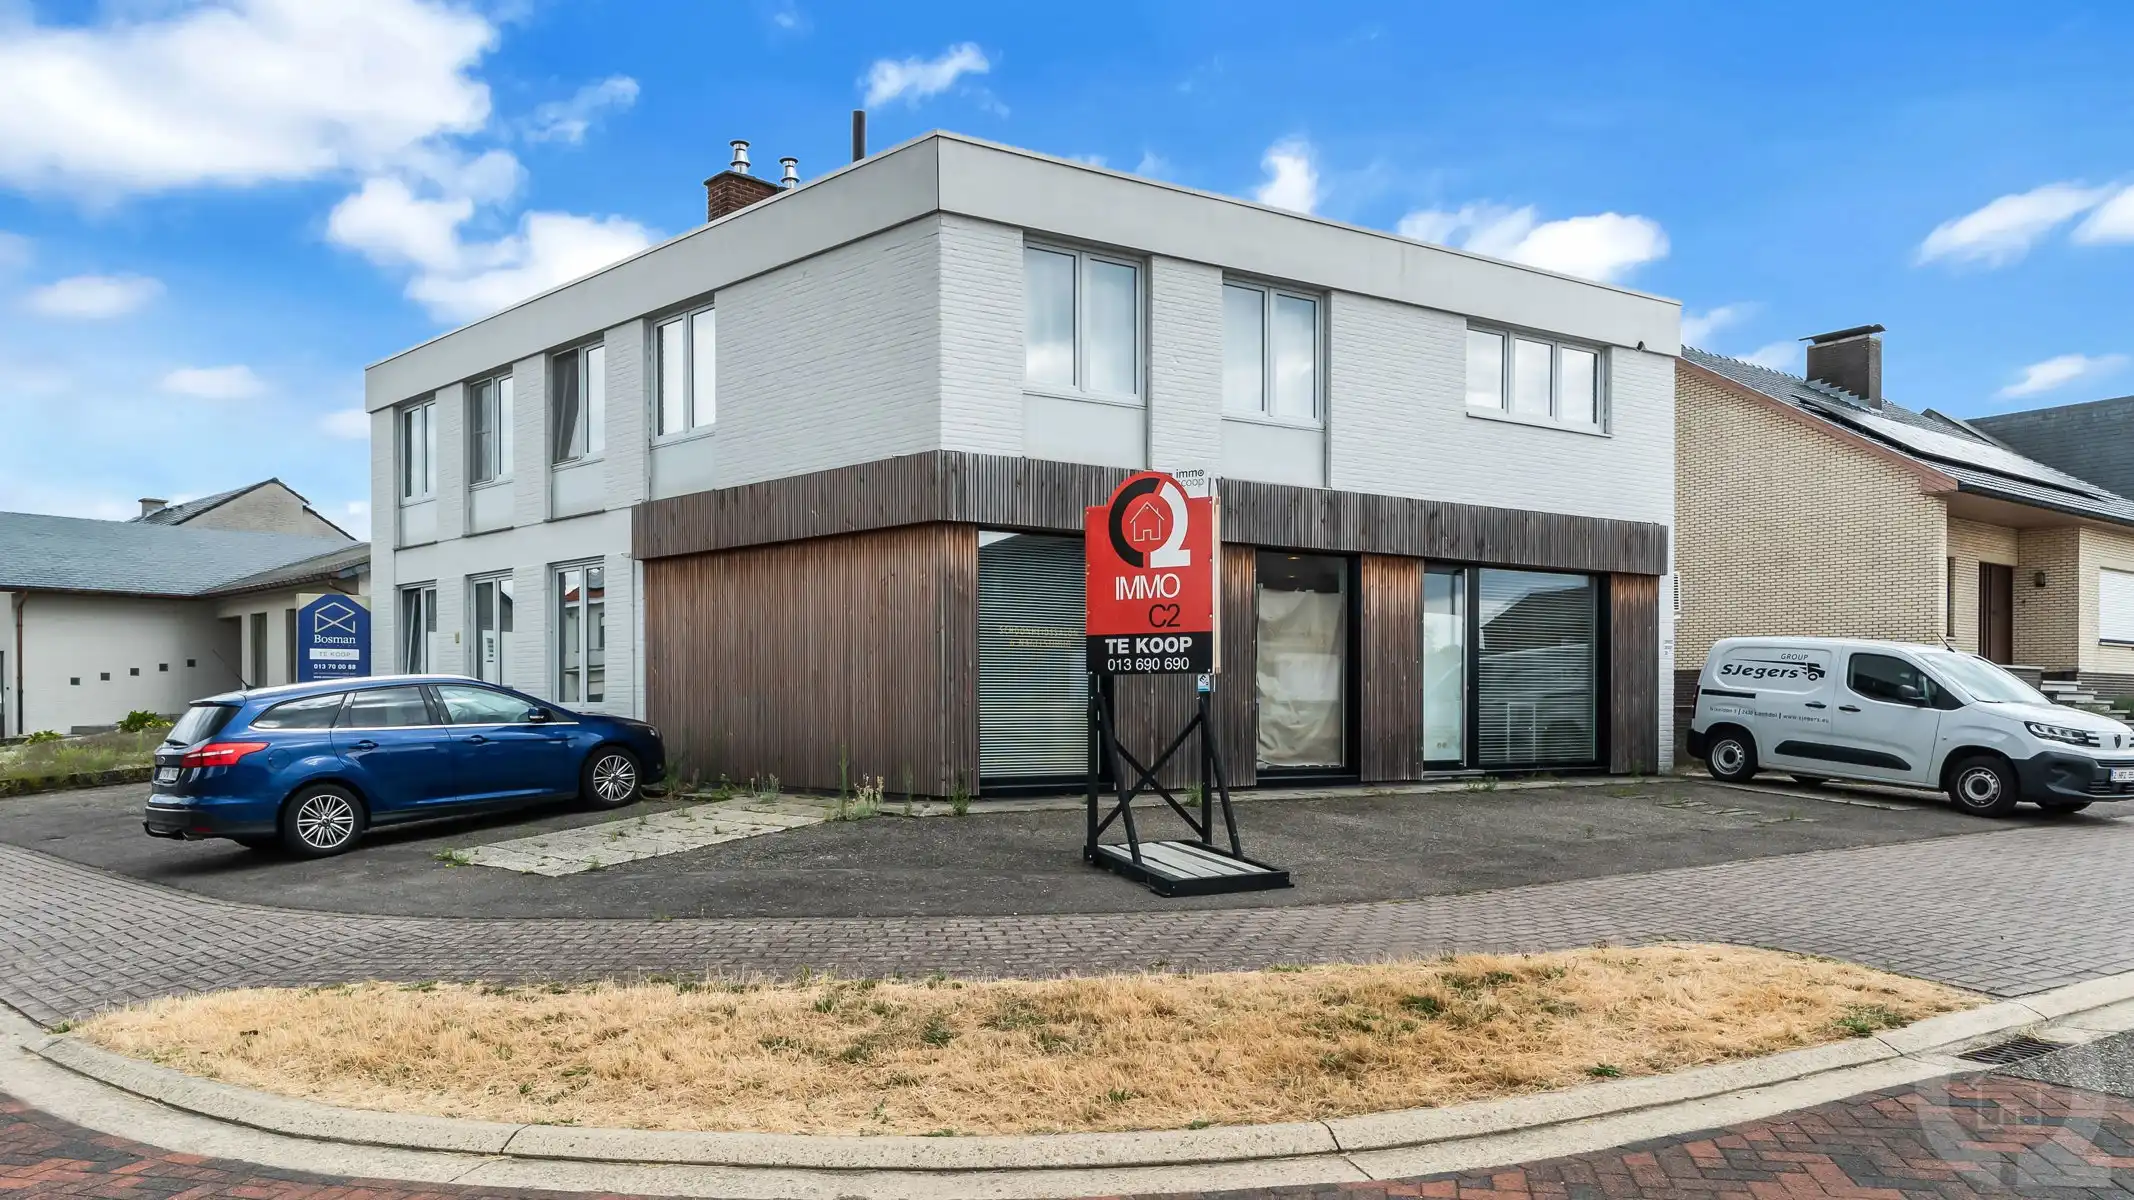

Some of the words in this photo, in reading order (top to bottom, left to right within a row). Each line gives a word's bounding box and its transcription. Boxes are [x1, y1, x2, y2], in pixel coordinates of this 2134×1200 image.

[1176, 468, 1205, 479] immo
[1179, 478, 1205, 488] coop
[1115, 573, 1181, 601] IMMO
[1149, 603, 1181, 628] C2
[314, 634, 356, 644] Bosman
[1105, 638, 1130, 655] TE
[1135, 636, 1193, 654] KOOP
[1780, 653, 1809, 661] GROUP
[1107, 658, 1132, 671] 013
[1135, 658, 1160, 671] 690
[1164, 657, 1190, 670] 690
